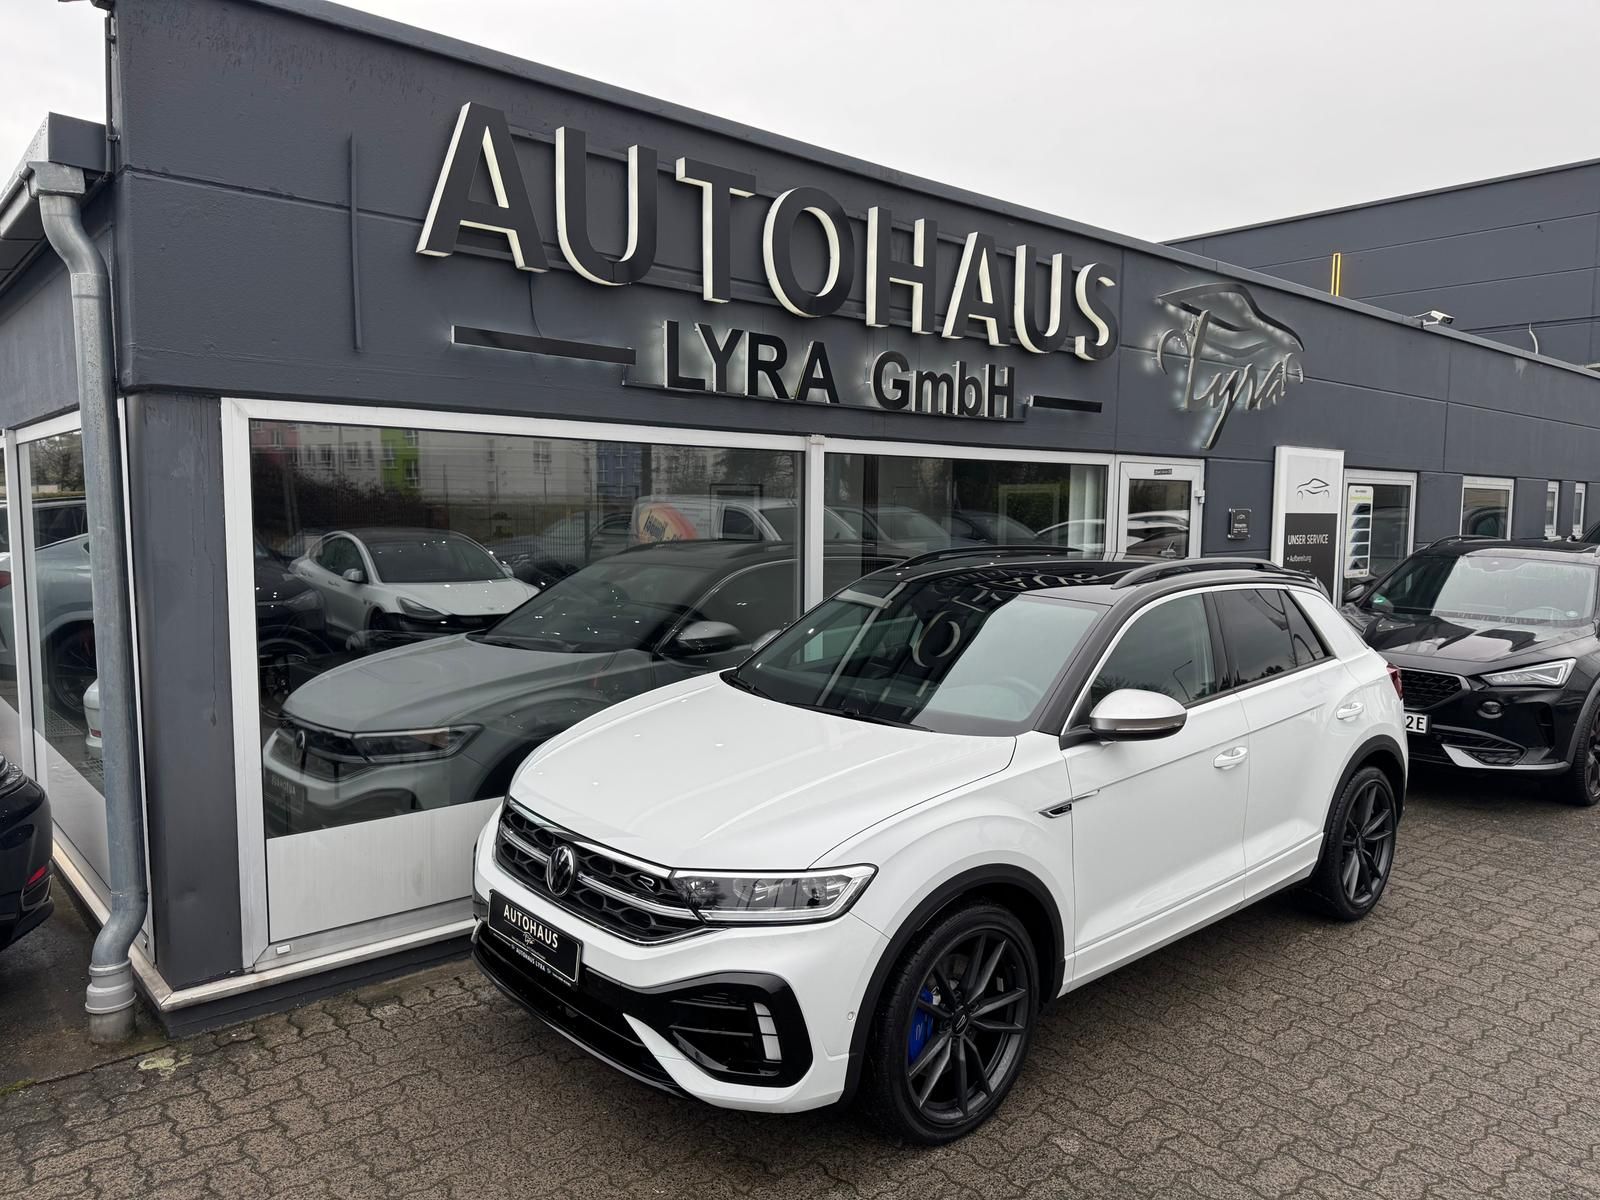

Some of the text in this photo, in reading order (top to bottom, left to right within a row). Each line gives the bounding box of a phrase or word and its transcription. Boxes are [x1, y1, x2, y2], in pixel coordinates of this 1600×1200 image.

[416, 101, 1119, 361] AUTOHAUS
[663, 320, 1015, 418] LYRA GmbH
[1287, 533, 1329, 545] UNSER SERVICE
[503, 904, 559, 949] AUTOHAUS
